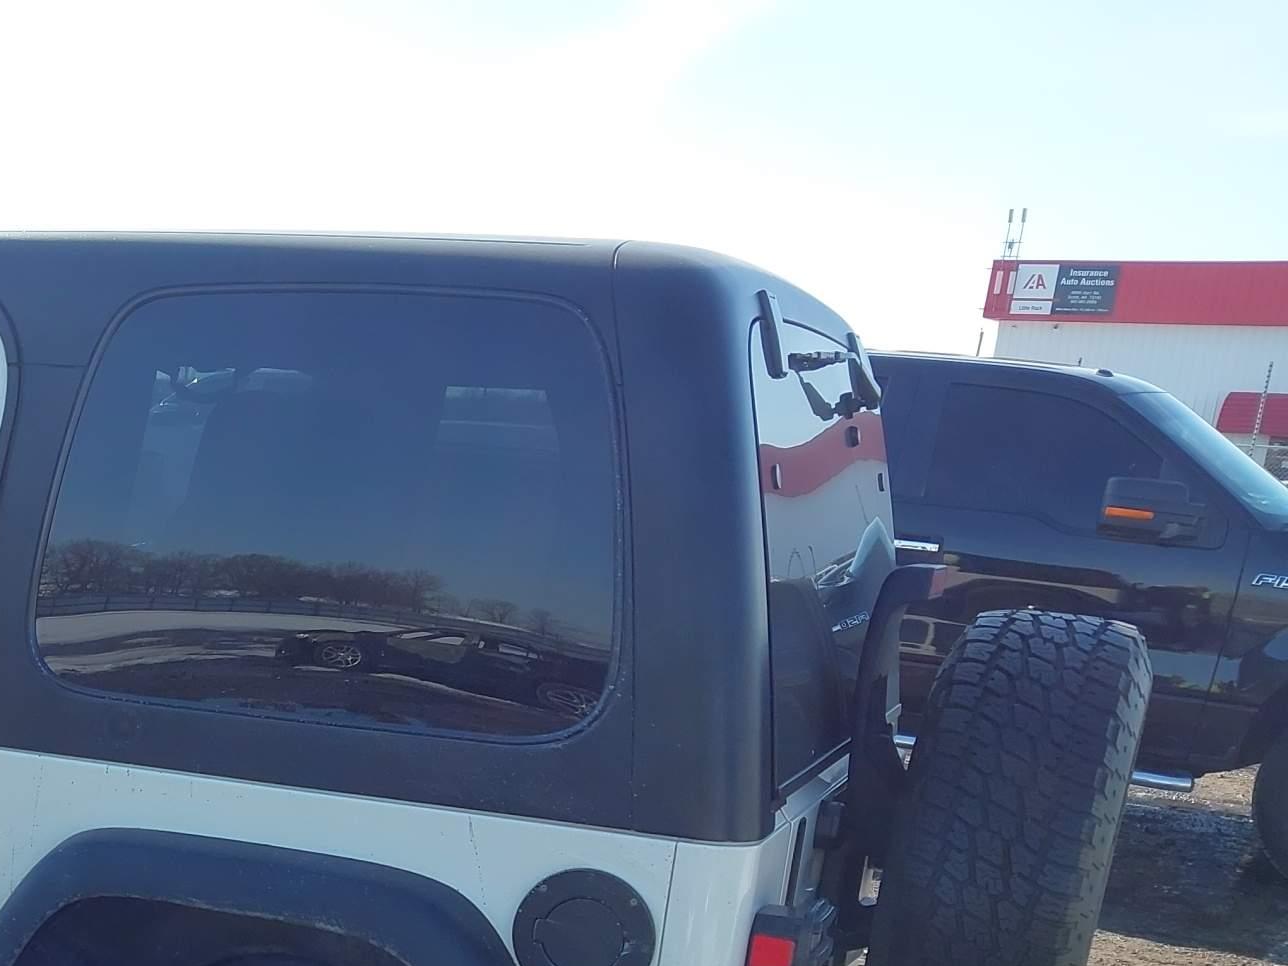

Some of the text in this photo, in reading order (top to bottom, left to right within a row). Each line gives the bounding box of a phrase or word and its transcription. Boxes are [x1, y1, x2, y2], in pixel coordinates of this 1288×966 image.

[1070, 269, 1108, 277] Insurance
[1060, 277, 1115, 287] Auto Auctions
